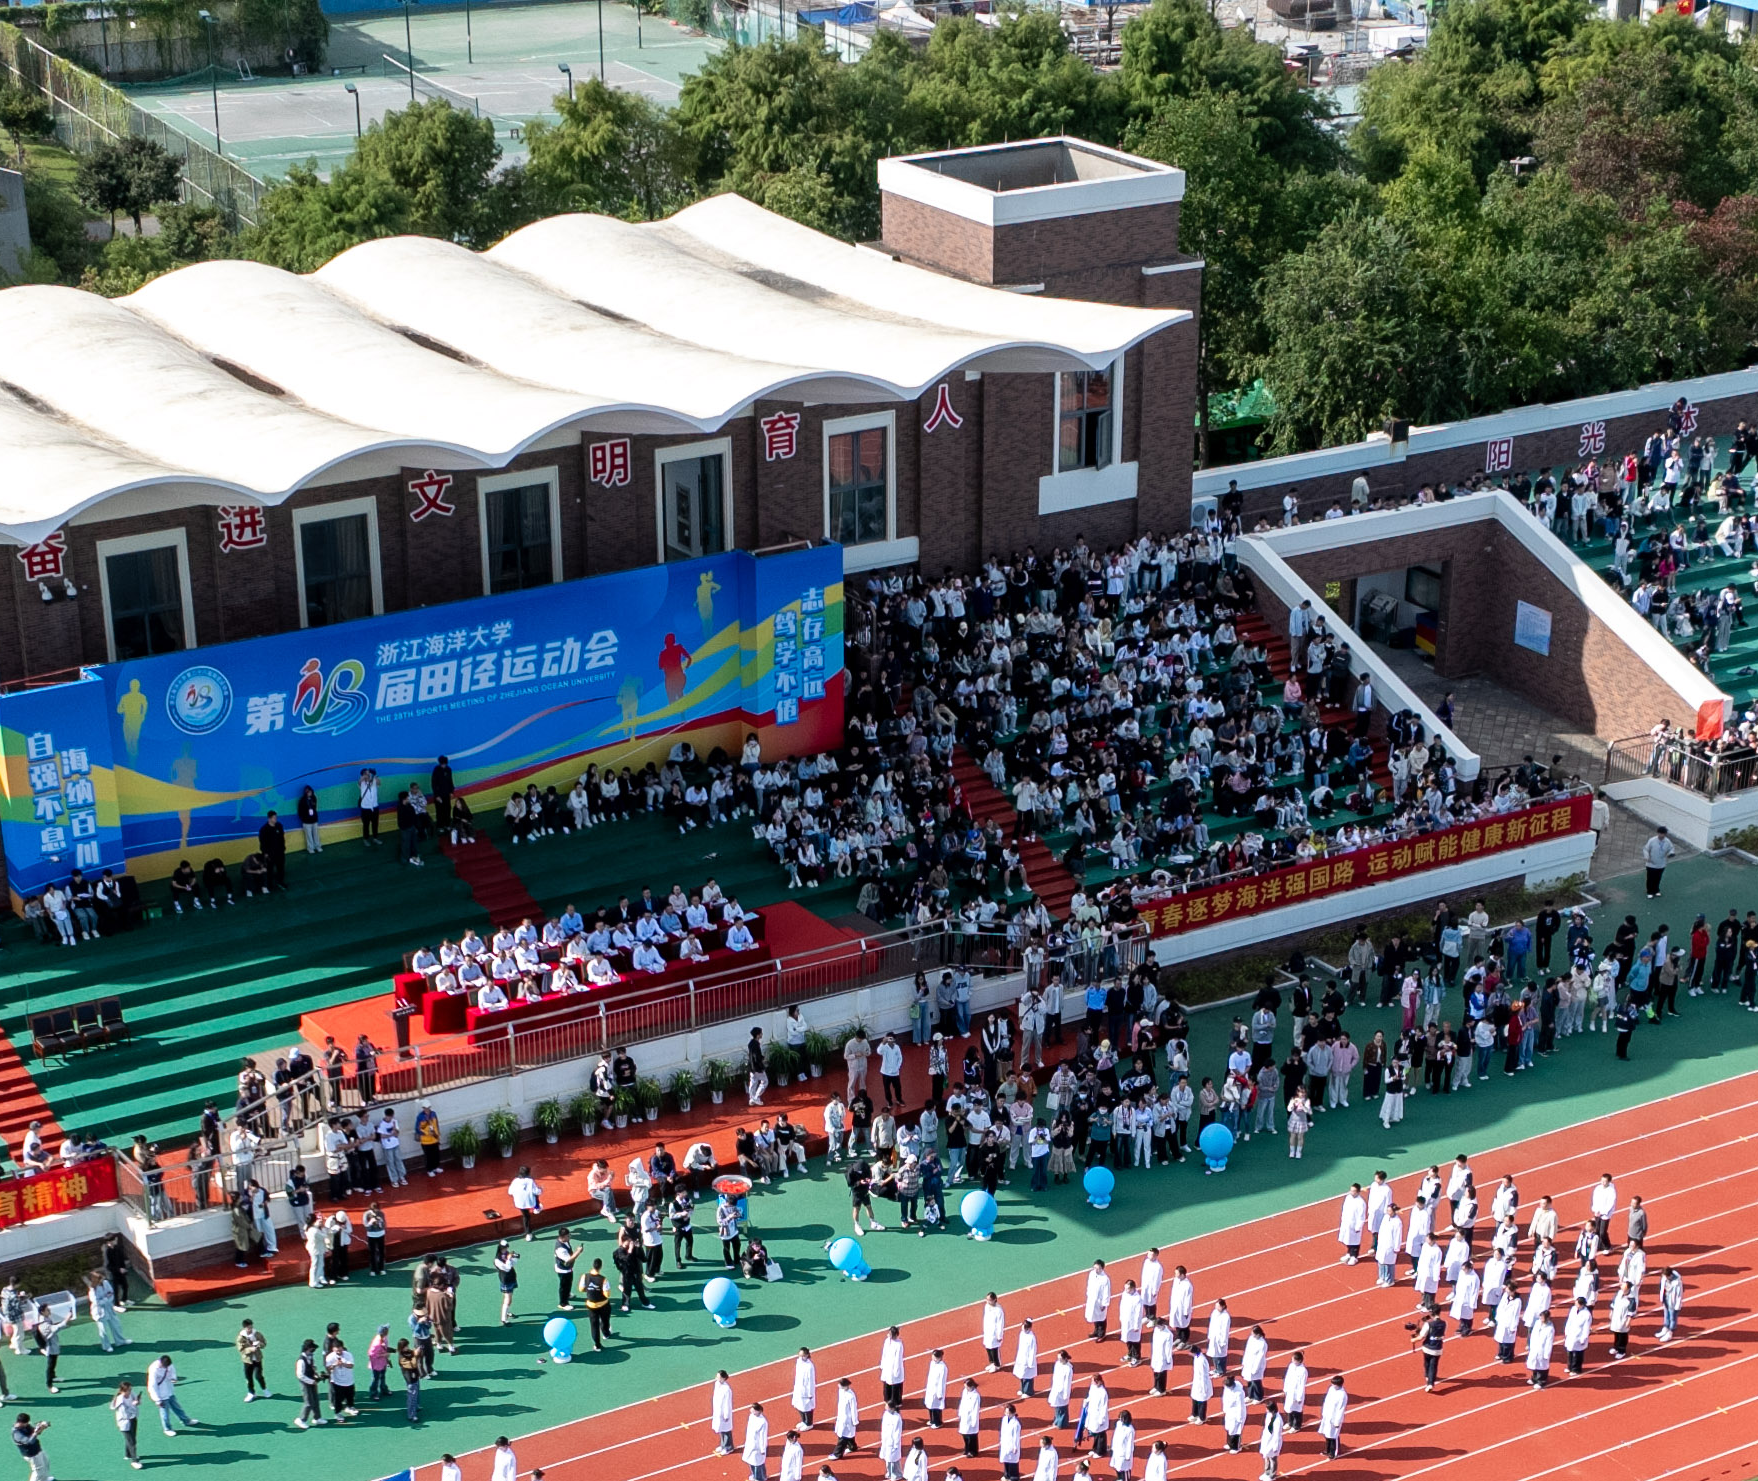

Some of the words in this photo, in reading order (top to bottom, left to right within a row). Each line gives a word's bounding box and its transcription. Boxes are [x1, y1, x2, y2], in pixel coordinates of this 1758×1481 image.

[375, 620, 513, 667] 浙江海洋大学
[375, 714, 391, 724] THE
[394, 711, 413, 721] 28TH
[416, 705, 448, 717] SPORTS
[450, 696, 485, 710] MEETING
[487, 694, 497, 702] OF
[500, 686, 539, 700] ZHEJIANG
[541, 681, 569, 692] OCEAN
[571, 671, 616, 686] UNIVERSITY
[774, 610, 799, 726] 笃学不倦
[800, 586, 825, 699] 志存高远
[27, 732, 68, 853] 自强不息
[61, 748, 101, 869] 海纳百川
[1139, 858, 1355, 936] 青春逐梦海洋强国路
[1366, 805, 1573, 874] 运动赋能健康新征程
